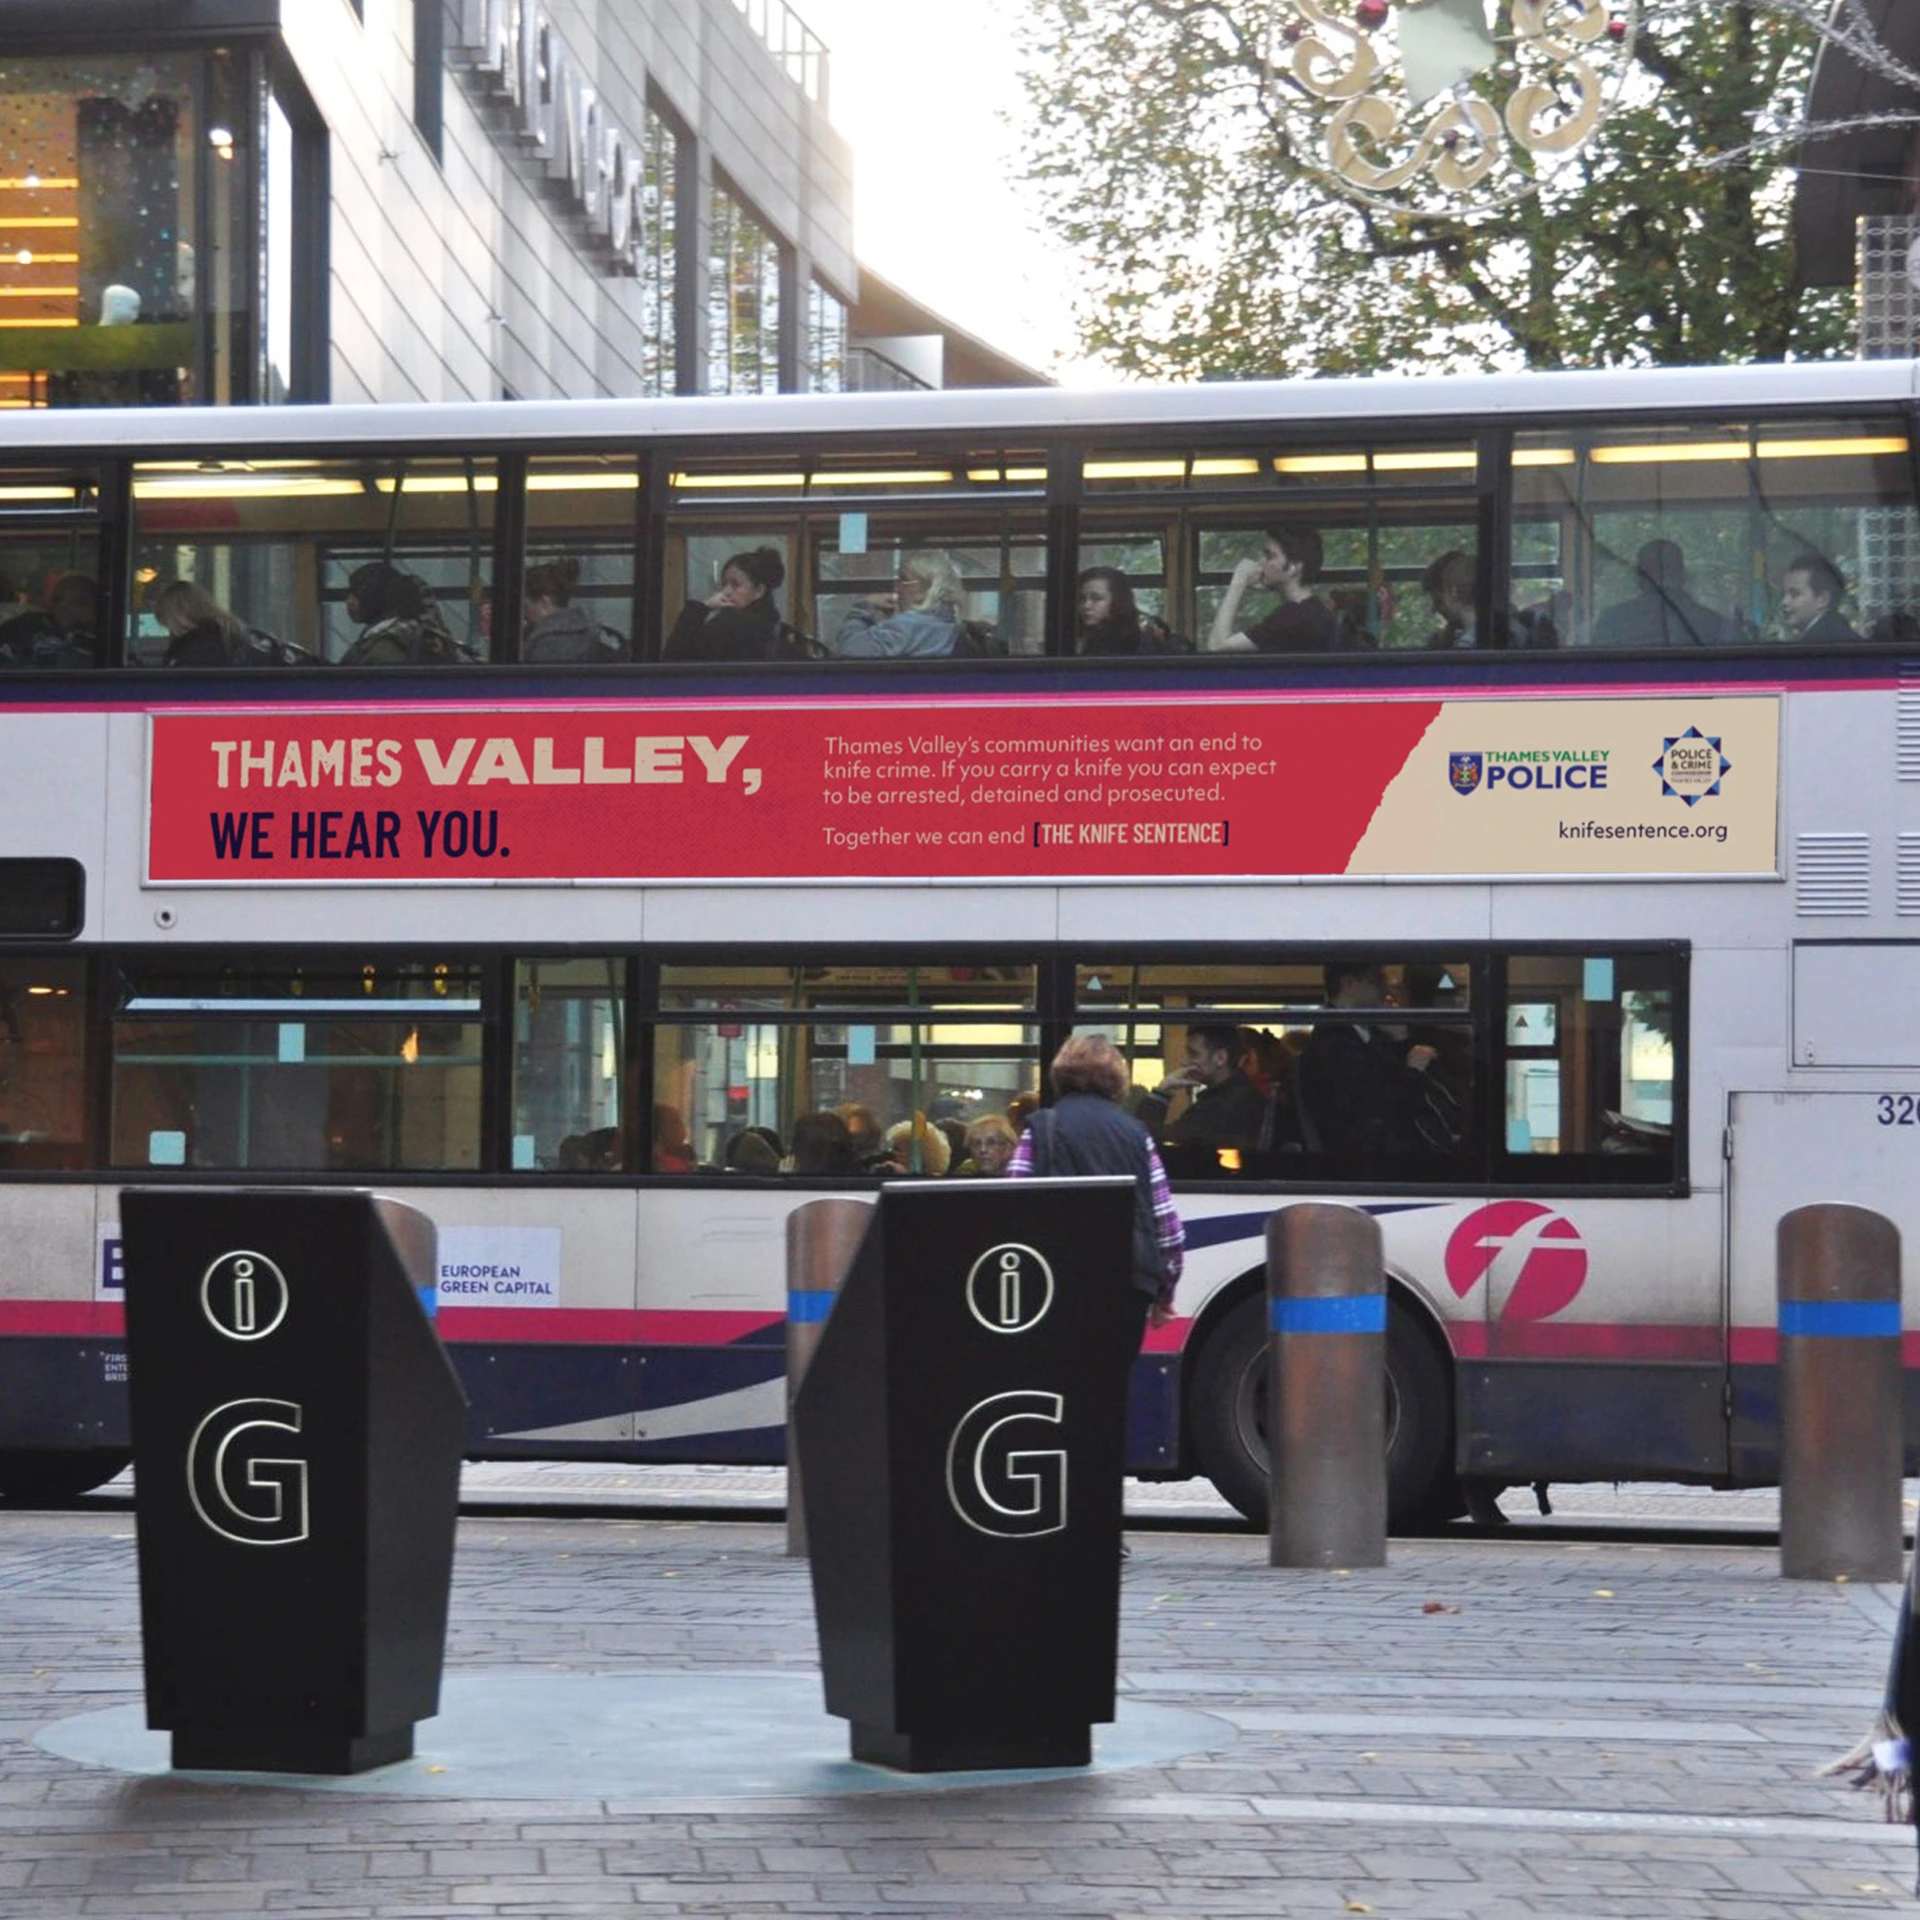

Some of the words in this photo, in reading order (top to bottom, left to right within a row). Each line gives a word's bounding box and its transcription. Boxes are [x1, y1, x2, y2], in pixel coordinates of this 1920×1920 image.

[824, 735, 903, 755] Thames
[907, 734, 980, 759] Valley's
[984, 734, 1110, 754] communities
[1114, 736, 1165, 753] want
[1169, 738, 1194, 752] an
[1199, 731, 1237, 752] end
[1241, 735, 1263, 751] to
[1485, 750, 1550, 762] THAMES
[1551, 750, 1611, 762] VALLEY
[1670, 748, 1712, 760] POLICE
[210, 738, 403, 788] THAMES
[413, 734, 763, 796] VALLEY,
[824, 759, 872, 779] knife
[875, 760, 936, 779] crime.
[941, 758, 957, 778] If
[959, 764, 995, 783] you
[999, 764, 1052, 782] carry
[1056, 763, 1069, 777] a
[1074, 757, 1123, 777] knife
[1127, 762, 1163, 781] you
[1167, 762, 1204, 776] can
[1208, 759, 1277, 780] expect
[1486, 765, 1608, 790] POLICE
[1680, 760, 1712, 770] CRIME
[822, 789, 843, 805] to
[847, 785, 872, 805] be
[877, 784, 965, 806] arrested,
[970, 783, 1059, 804] detained
[1063, 783, 1103, 803] and
[1107, 781, 1225, 807] prosecuted.
[210, 810, 275, 859] WE
[290, 810, 402, 860] HEAR
[416, 809, 511, 858] YOU.
[822, 826, 911, 851] Together
[915, 831, 943, 845] we
[947, 831, 983, 845] can
[987, 825, 1025, 845] end
[1079, 823, 1128, 844] KNIFE
[1559, 820, 1729, 843] knifesentence.org
[1877, 1095, 1920, 1125] 32
[441, 1264, 521, 1279] EUROPEAN
[440, 1280, 490, 1294] GREEN
[493, 1281, 553, 1295] CAPITAL
[188, 1398, 308, 1545] G
[947, 1390, 1066, 1537] G
